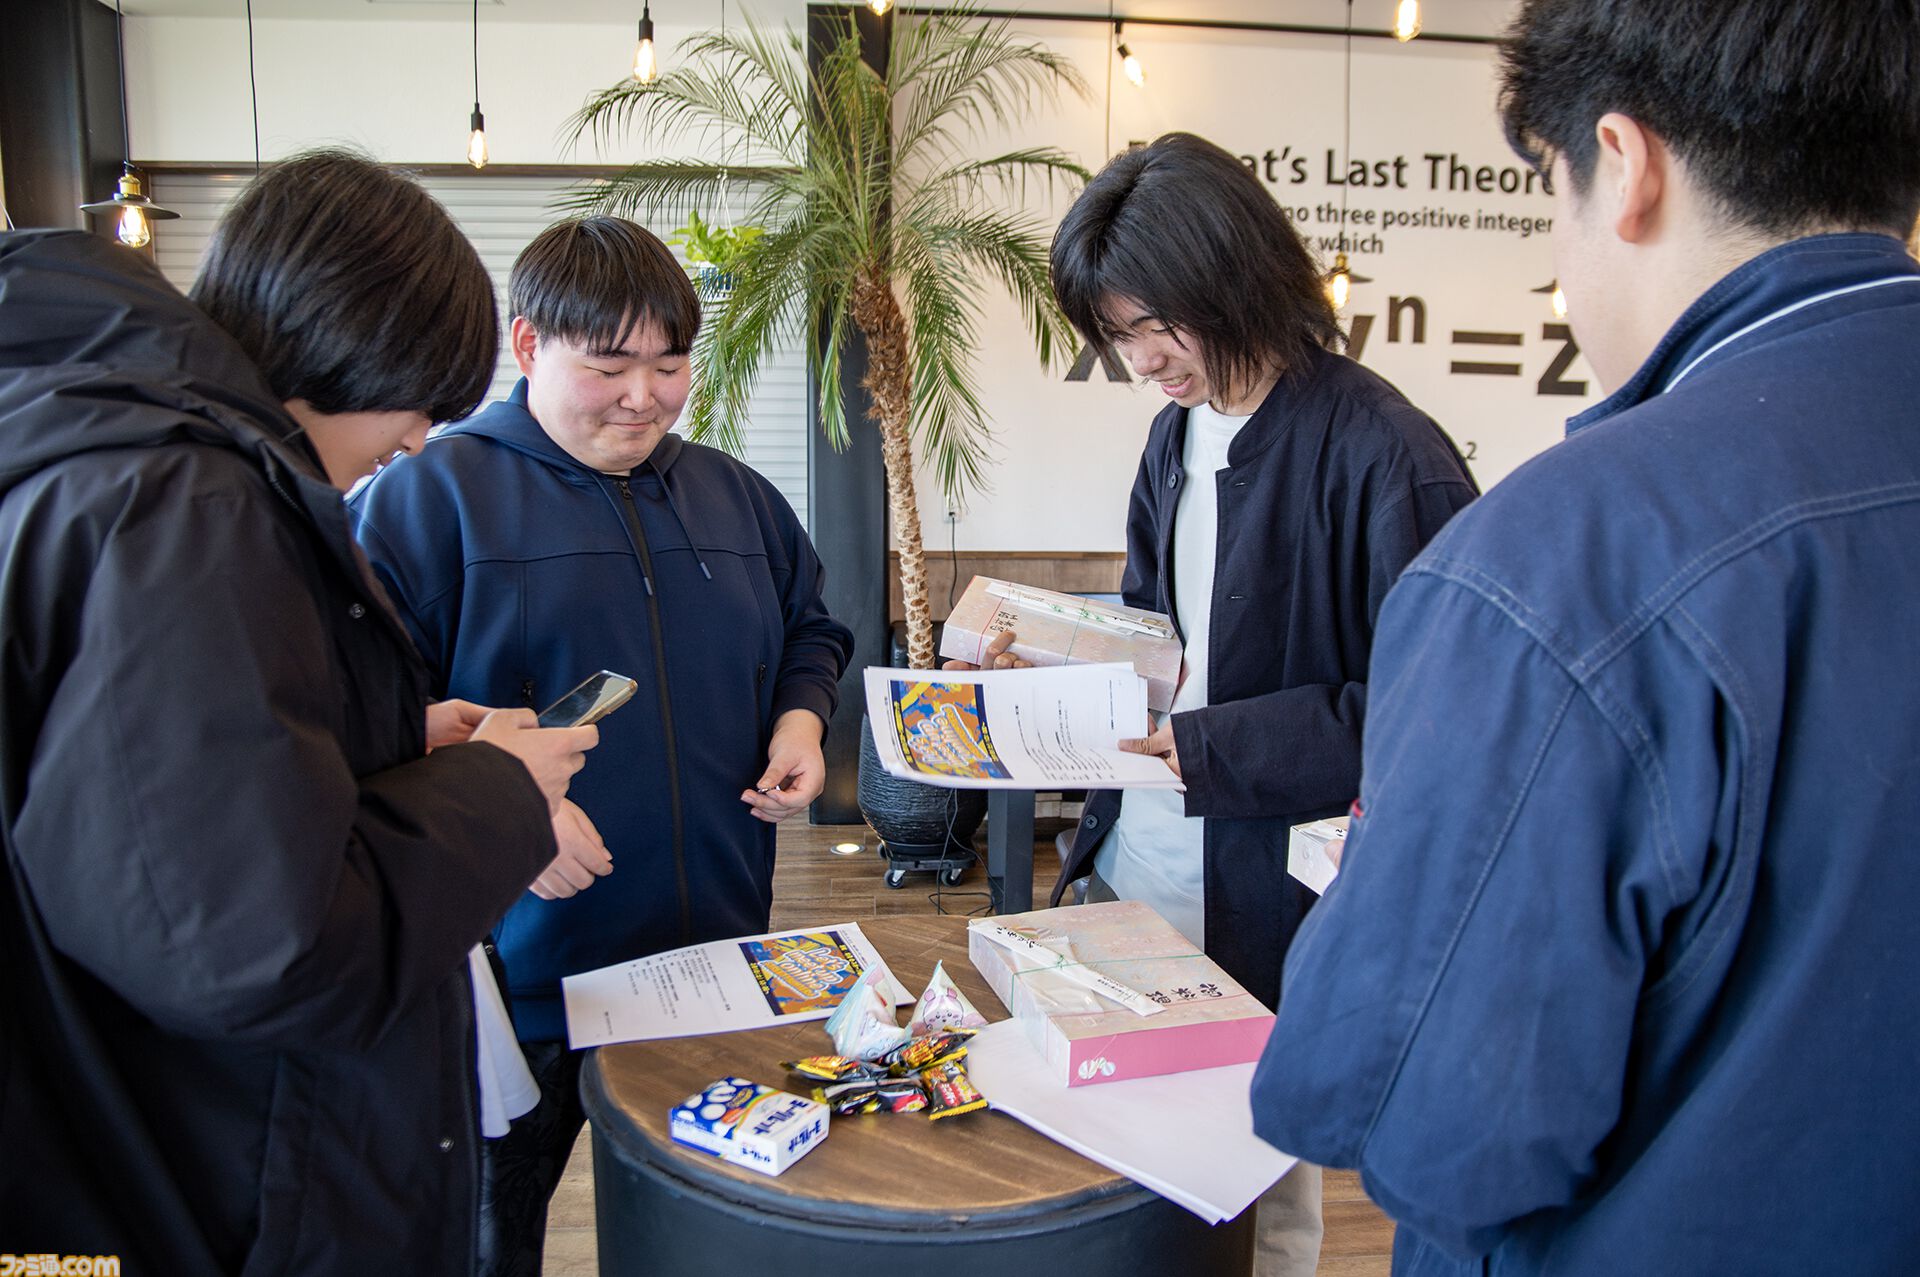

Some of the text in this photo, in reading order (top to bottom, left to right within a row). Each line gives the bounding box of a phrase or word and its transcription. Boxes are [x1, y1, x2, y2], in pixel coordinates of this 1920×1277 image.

[1326, 149, 1408, 188] Last
[1316, 202, 1376, 225] three
[1382, 206, 1470, 231] positive
[1318, 231, 1384, 253] which
[1466, 441, 1477, 460] 2
